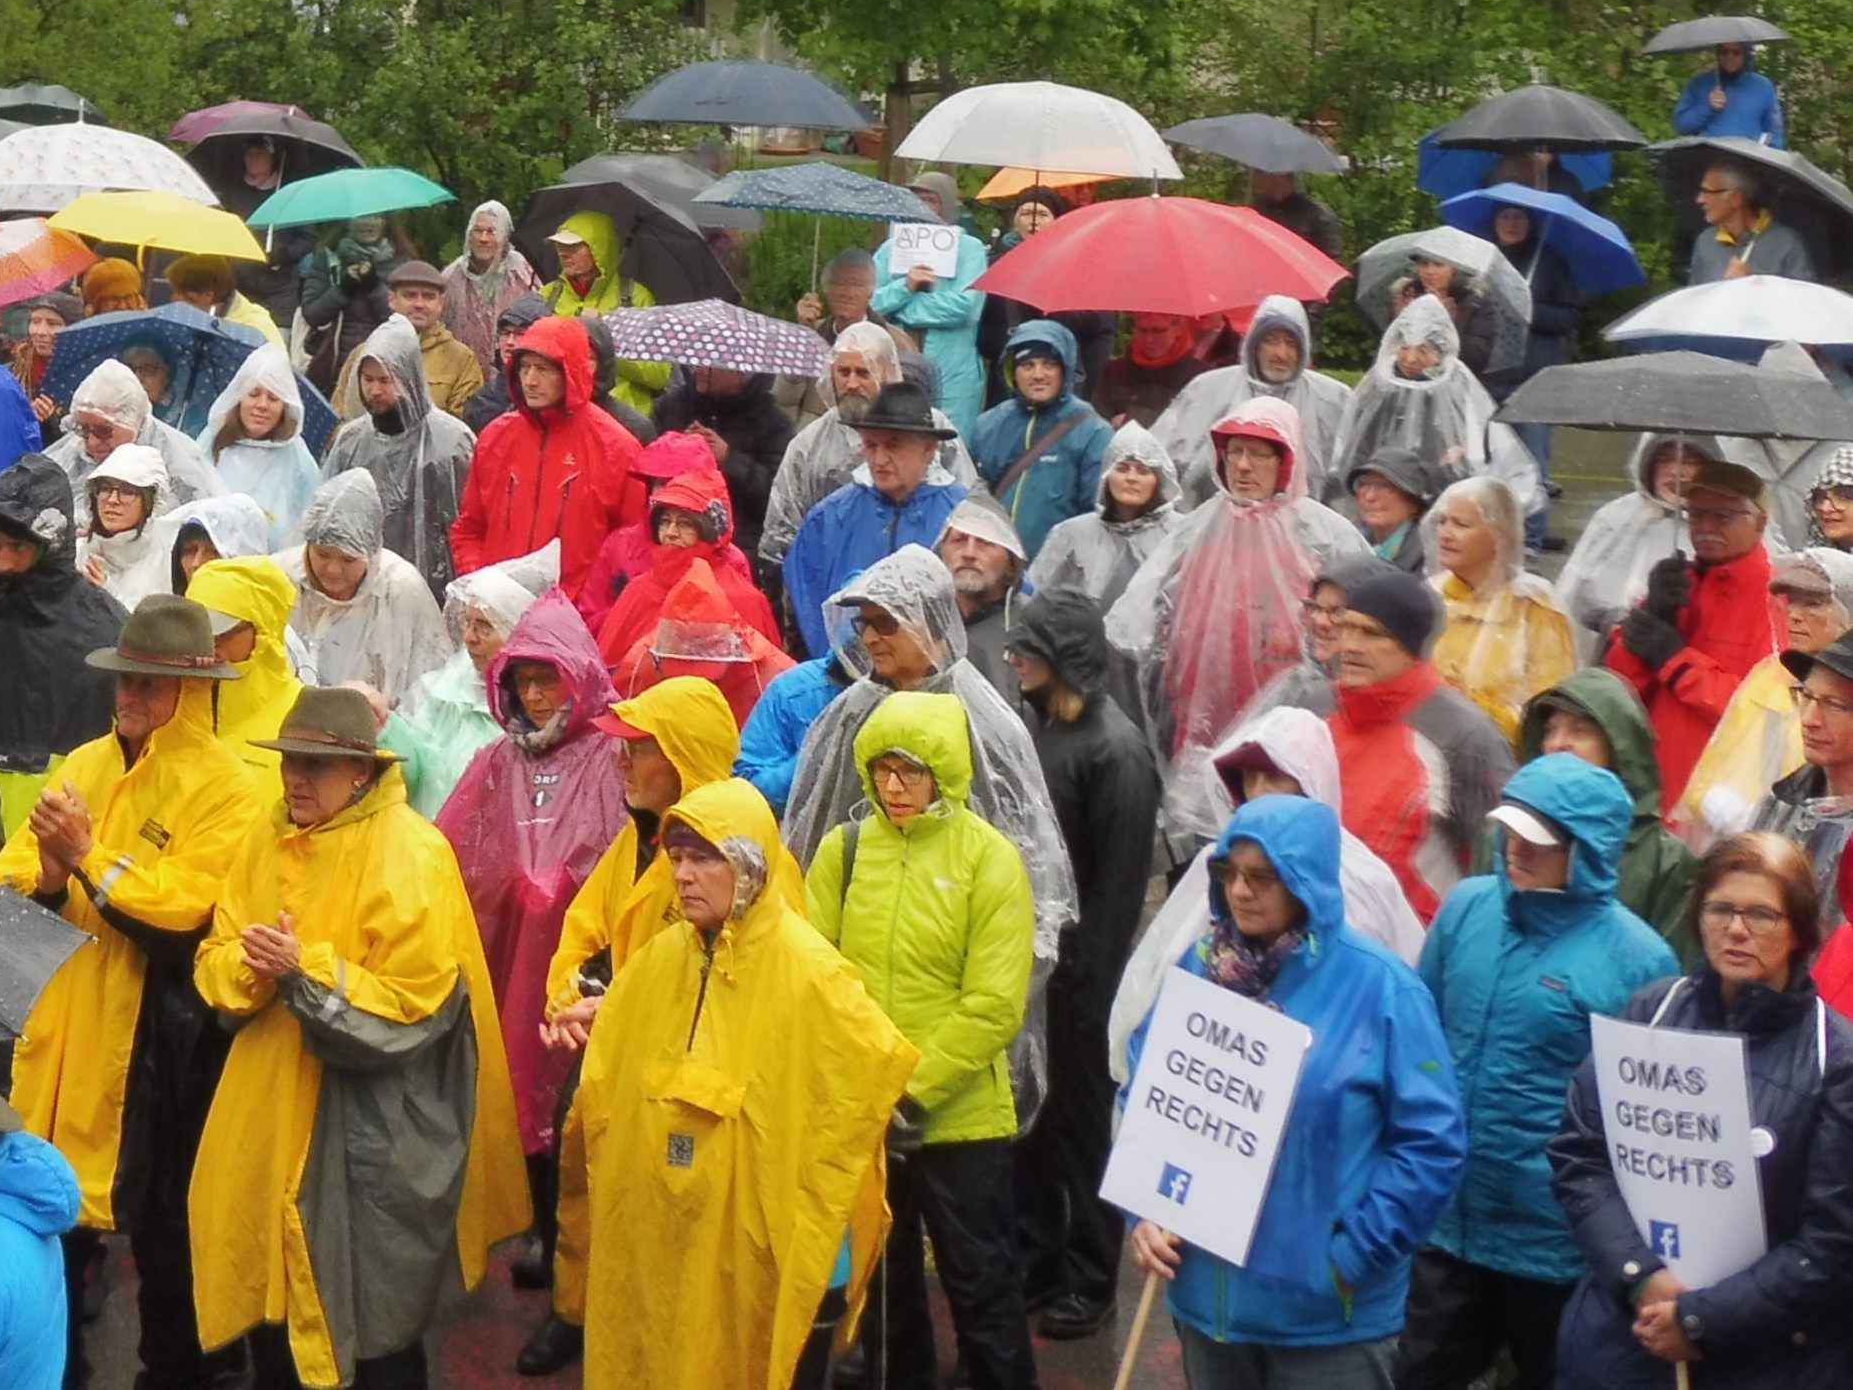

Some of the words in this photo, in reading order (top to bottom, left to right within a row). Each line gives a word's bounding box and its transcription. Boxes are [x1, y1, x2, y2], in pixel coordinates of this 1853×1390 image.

[896, 226, 954, 251] APO
[1186, 1012, 1268, 1067] OMAS
[1166, 1049, 1265, 1114] GEGEN
[1618, 1056, 1707, 1096] OMAS
[1145, 1085, 1258, 1157] RECHTS
[1615, 1099, 1721, 1143] GEGEN
[1615, 1143, 1736, 1189] RECHTS
